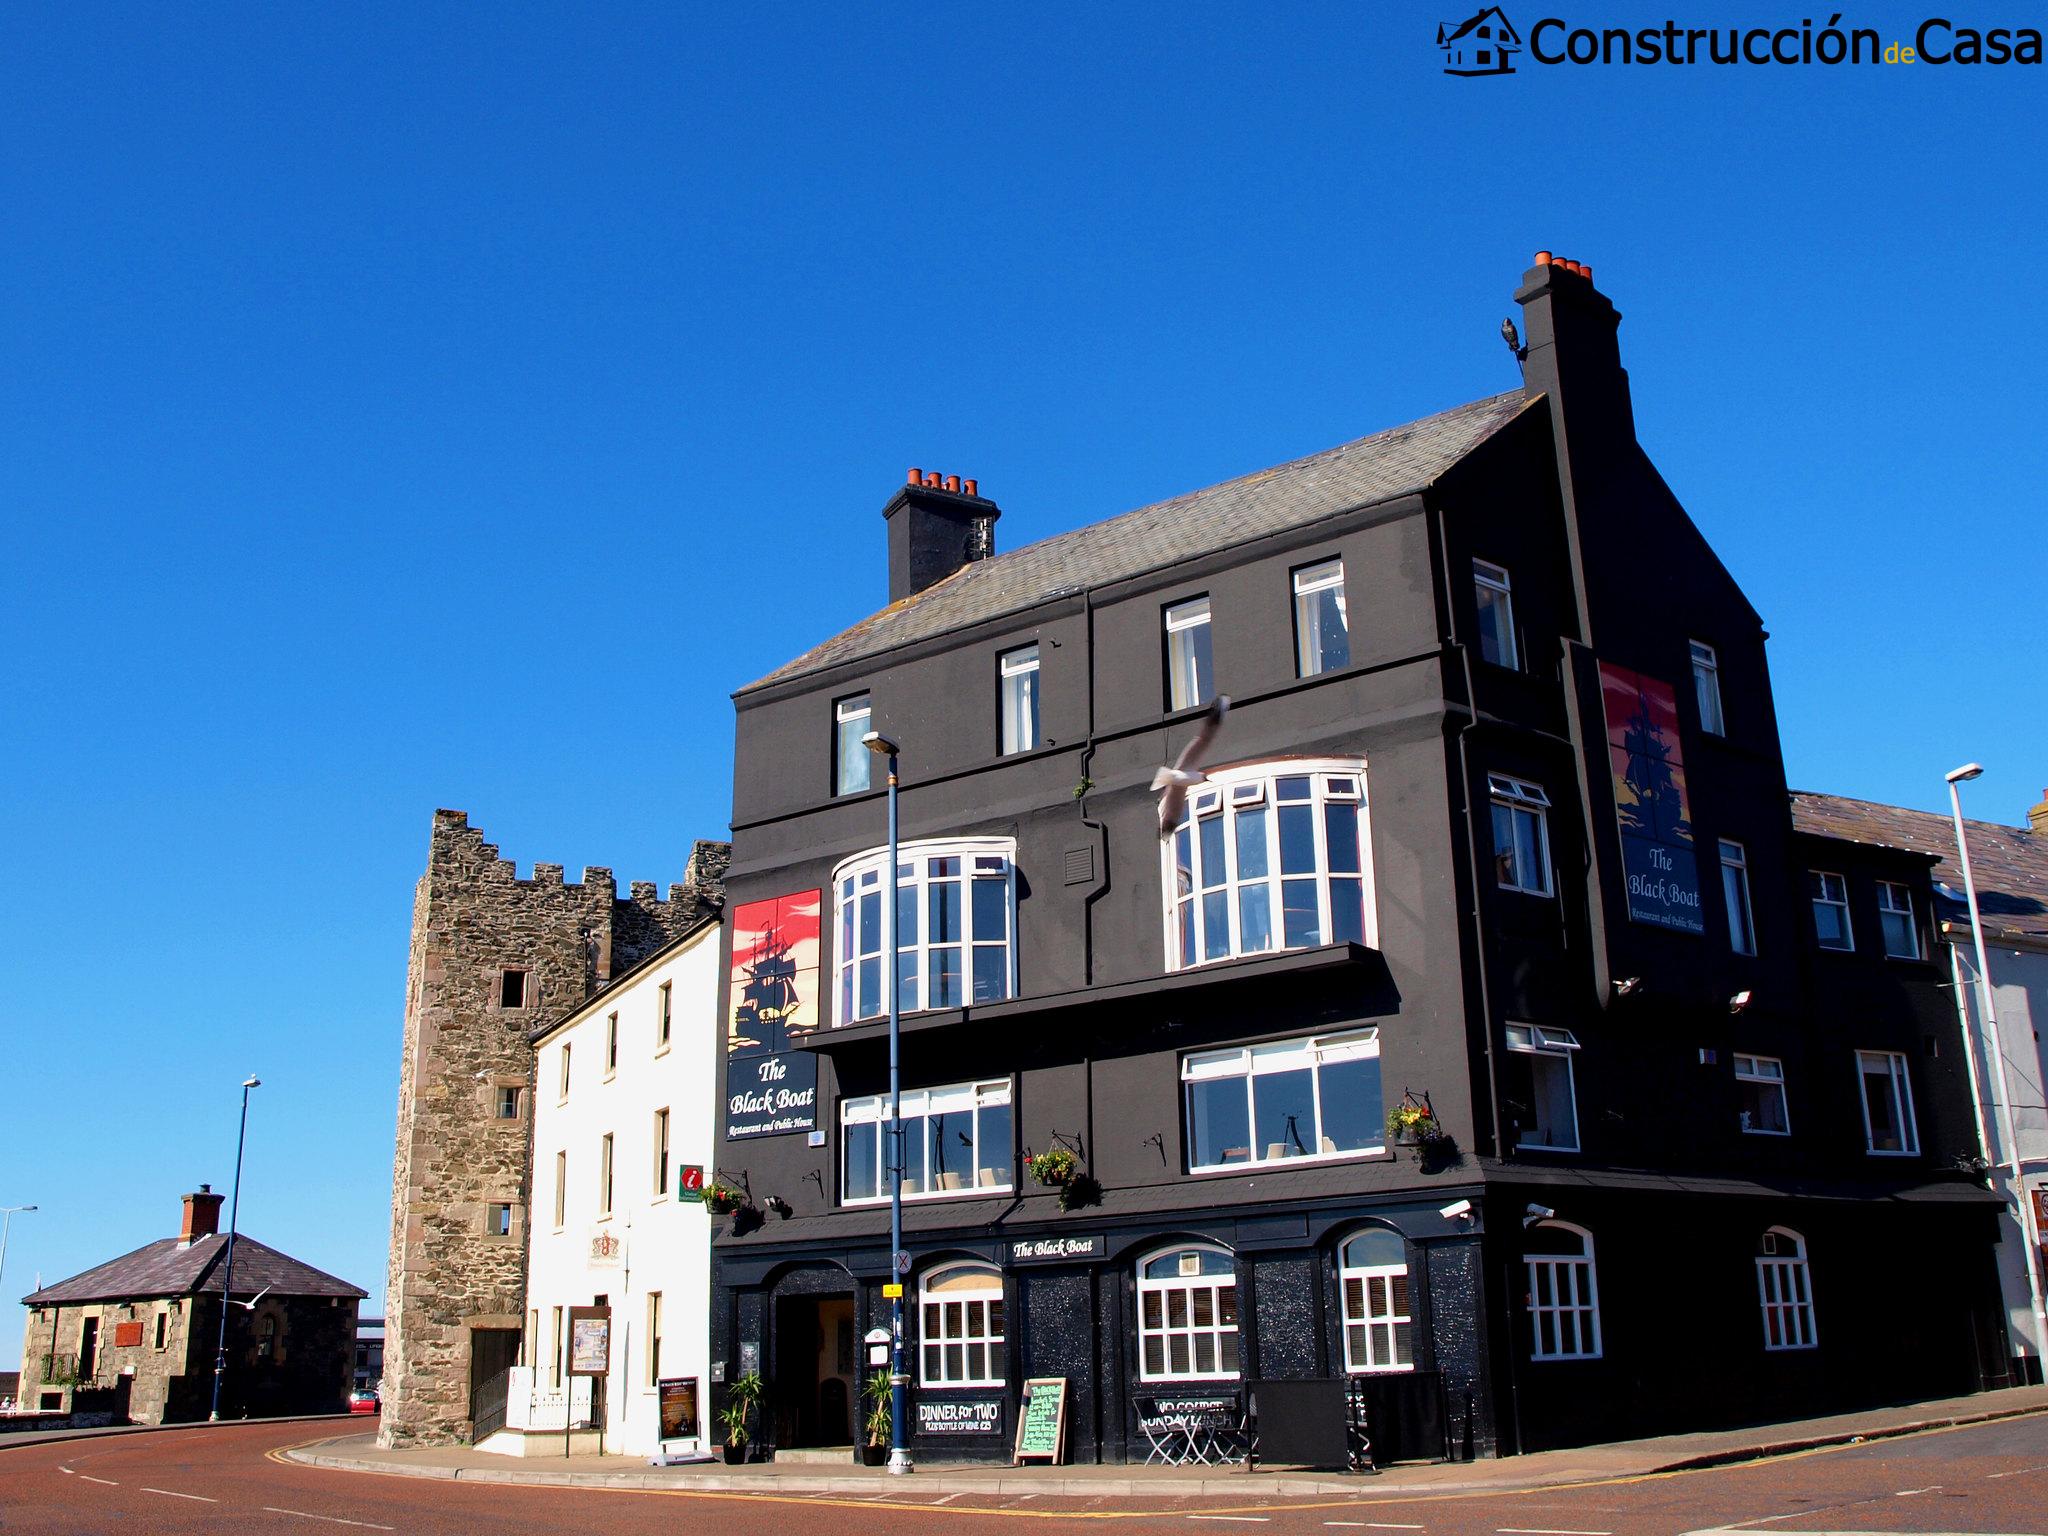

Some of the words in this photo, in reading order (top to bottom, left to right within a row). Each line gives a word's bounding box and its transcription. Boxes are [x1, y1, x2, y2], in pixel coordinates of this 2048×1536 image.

[1649, 848, 1672, 871] The
[1628, 874, 1670, 906] Black
[1669, 883, 1700, 907] Boat
[759, 1058, 787, 1082] The
[730, 1088, 776, 1114] Black
[776, 1088, 814, 1108] Boat
[729, 1124, 761, 1137] Restaurant
[762, 1120, 775, 1132] and
[774, 1117, 793, 1130] Public
[793, 1116, 813, 1128] House
[1013, 1241, 1033, 1257] The
[1034, 1239, 1067, 1257] Black
[1066, 1239, 1093, 1253] Boat
[919, 1405, 958, 1421] DINNER
[958, 1405, 972, 1419] for
[973, 1403, 998, 1421] TWO
[938, 1421, 957, 1431] BOTTLE
